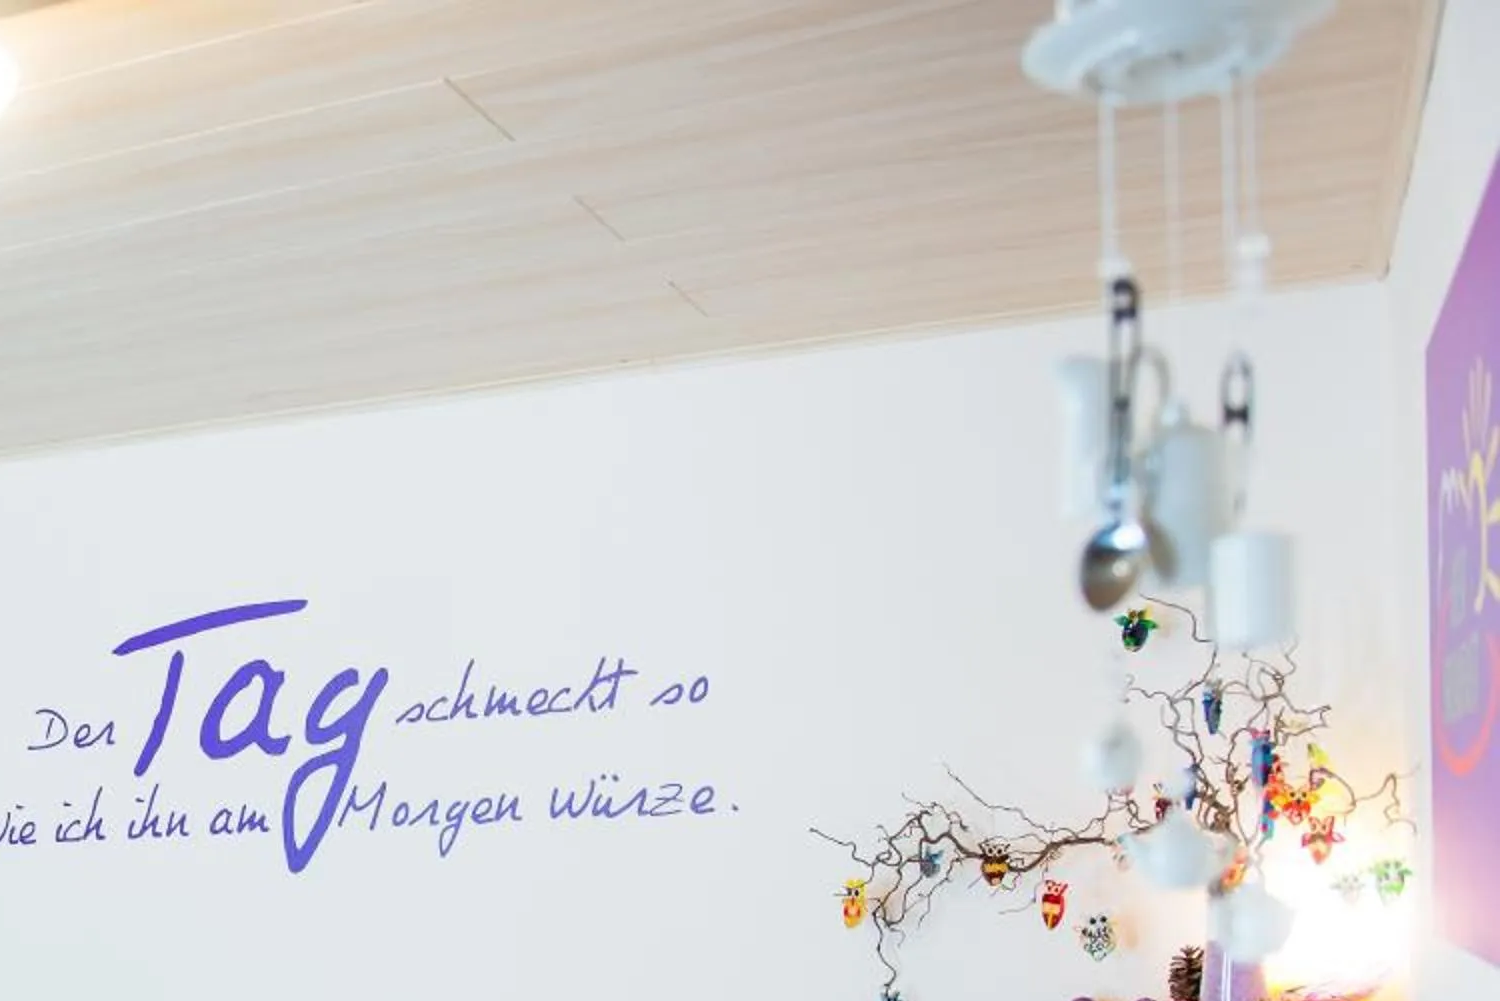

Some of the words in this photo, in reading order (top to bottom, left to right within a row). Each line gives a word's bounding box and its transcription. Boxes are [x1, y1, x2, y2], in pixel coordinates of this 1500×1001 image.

[26, 708, 116, 751] Der
[110, 598, 390, 875] Tag
[395, 656, 640, 725] schmeckt
[649, 675, 709, 707] so
[54, 785, 107, 844] ich
[126, 782, 191, 841] ihn
[208, 803, 271, 836] am
[337, 780, 523, 859] Morgen
